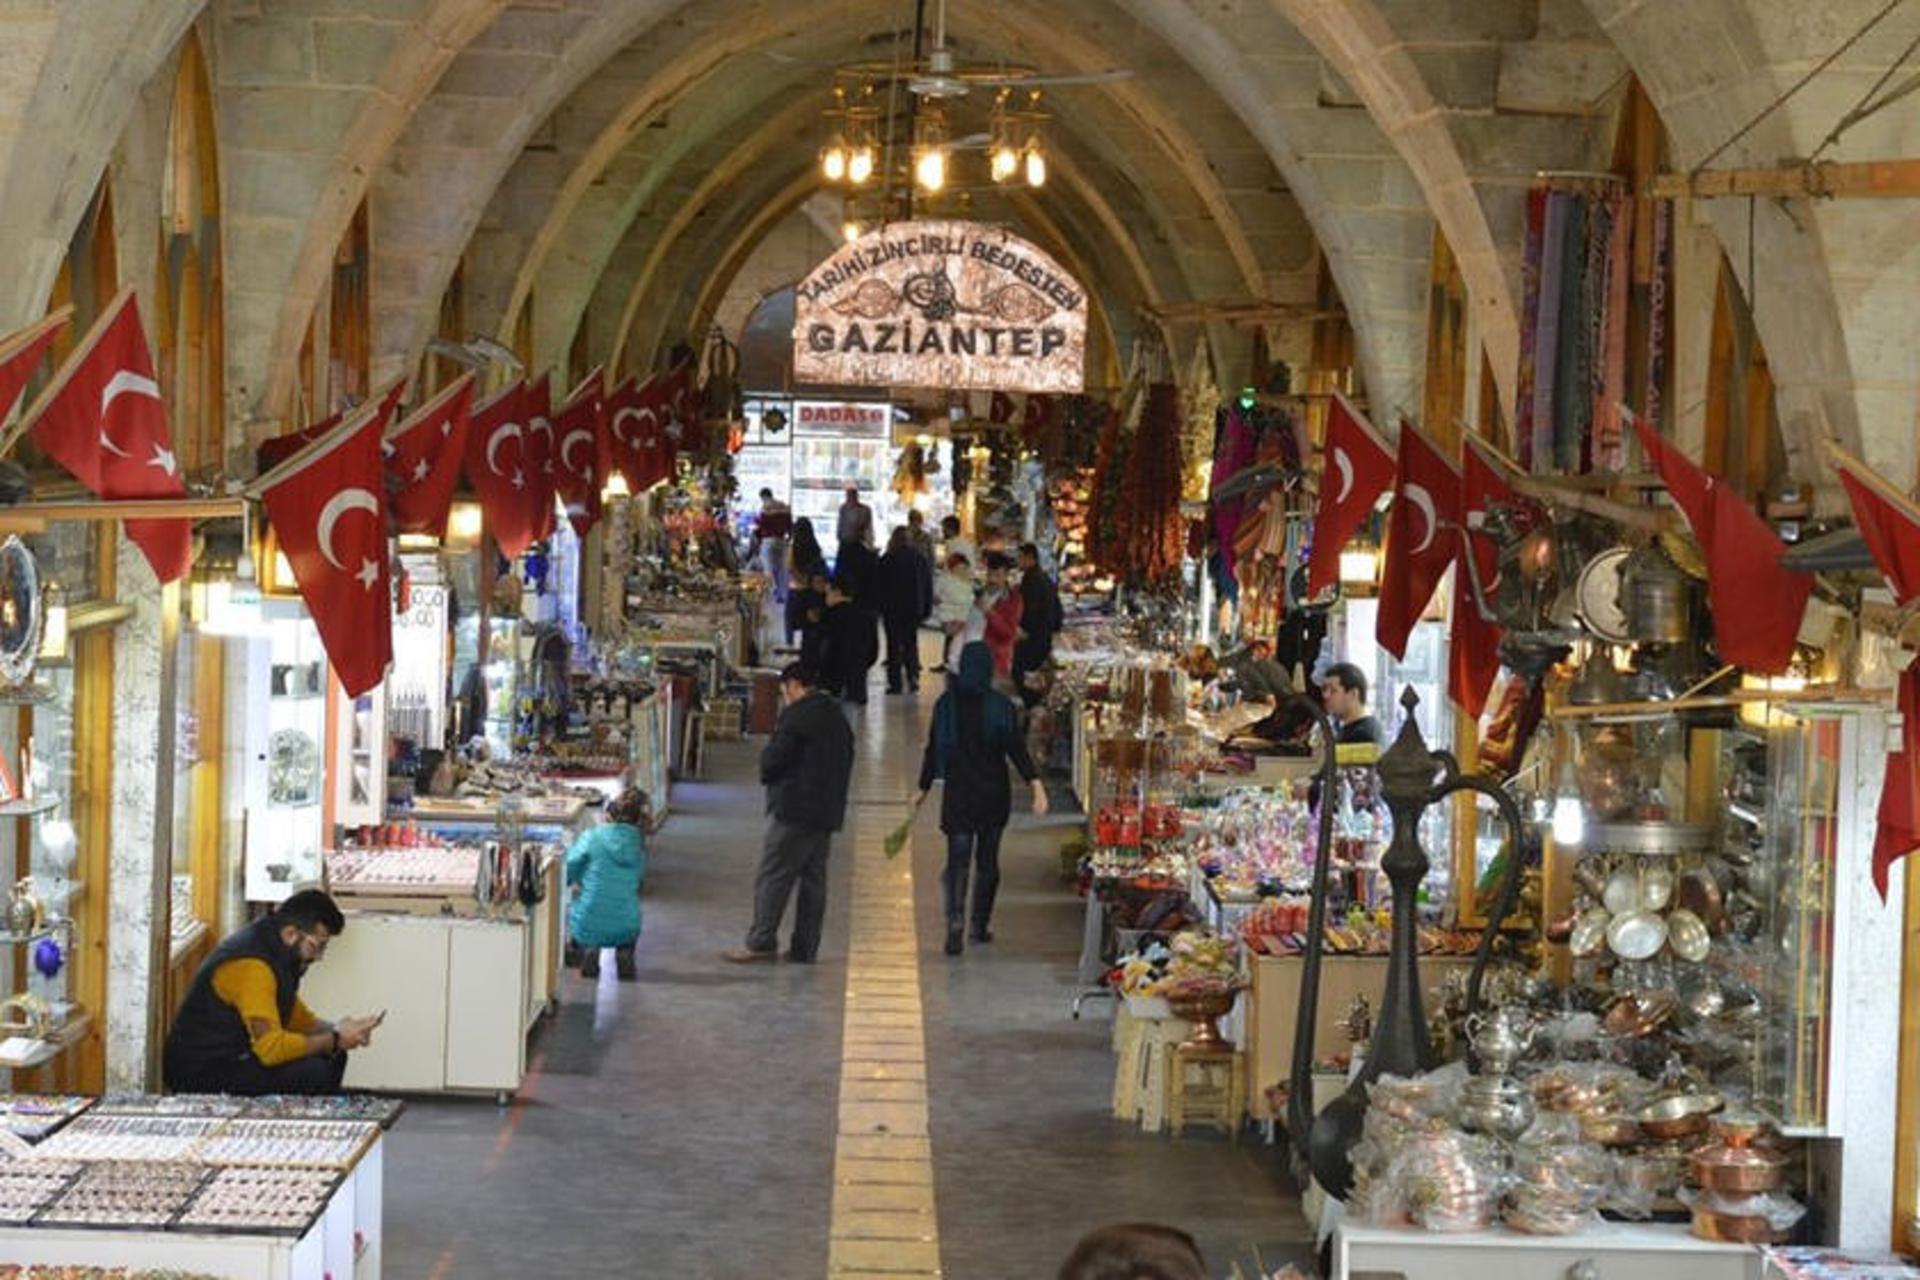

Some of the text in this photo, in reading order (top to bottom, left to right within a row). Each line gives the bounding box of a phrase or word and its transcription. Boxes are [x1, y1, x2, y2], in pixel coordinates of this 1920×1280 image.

[798, 234, 1081, 311] TARİHİ ZİNCİRLİ BEDESTEN
[808, 320, 1066, 357] GAZİANTEP
